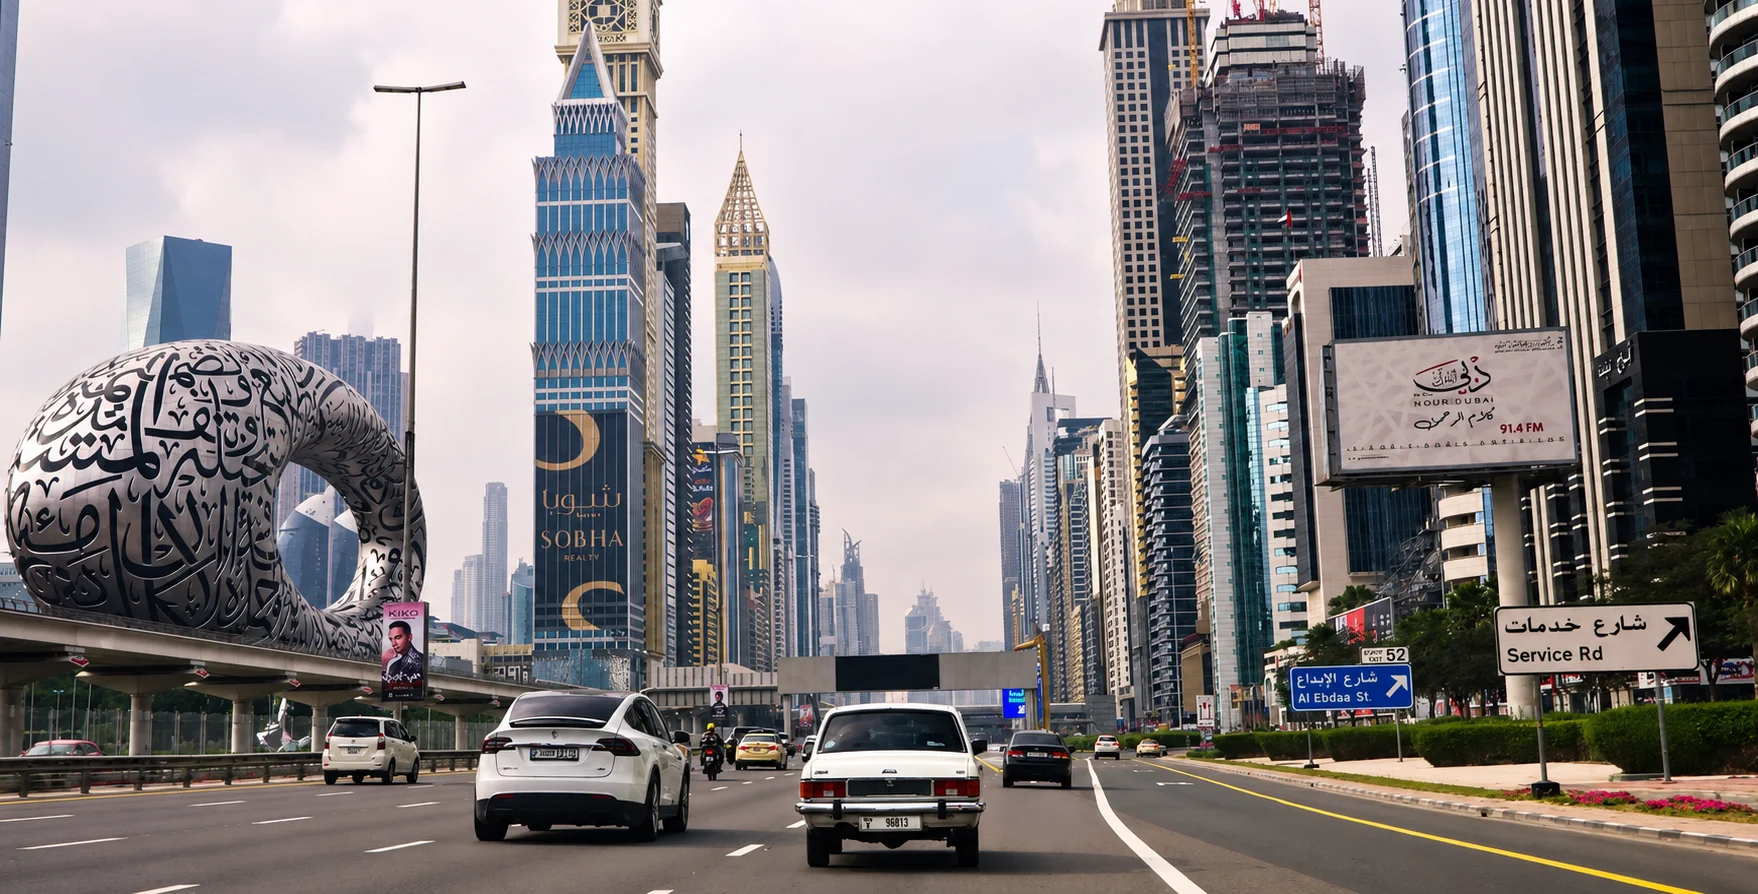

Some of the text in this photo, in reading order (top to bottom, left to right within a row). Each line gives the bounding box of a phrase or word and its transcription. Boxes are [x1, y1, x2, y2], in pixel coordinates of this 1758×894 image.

[1414, 398, 1449, 407] NOUR
[1500, 421, 1544, 434] 91.4 FM
[541, 529, 624, 549] SOBHA
[388, 609, 419, 617] KIKO
[1505, 614, 1647, 637] شارع خدمات
[1386, 648, 1406, 661] 52
[1507, 645, 1603, 663] Service Rd
[1296, 671, 1378, 688] شارع الإبداع
[1298, 690, 1372, 704] Al Ebdaa St.
